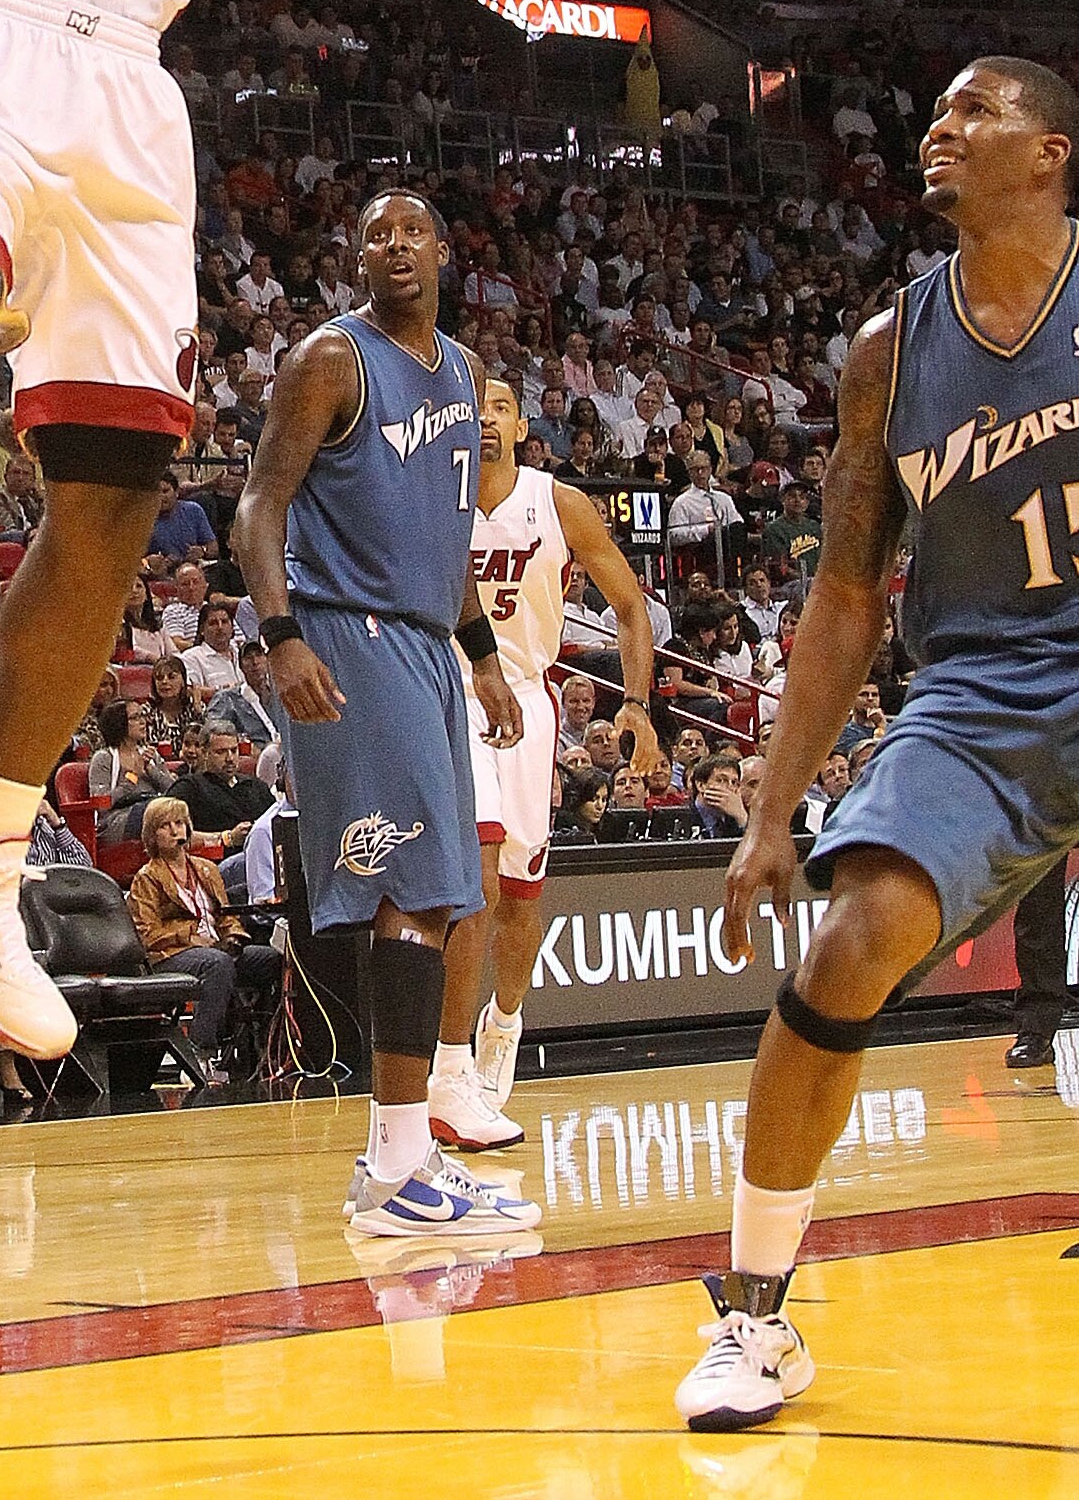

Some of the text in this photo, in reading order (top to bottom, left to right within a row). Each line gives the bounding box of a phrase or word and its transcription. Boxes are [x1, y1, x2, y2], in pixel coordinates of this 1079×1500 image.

[380, 401, 474, 466] WIZARDS
[896, 398, 1079, 514] WIZAR
[451, 447, 472, 512] 7
[471, 536, 542, 582] EAT
[631, 531, 661, 545] WIZARDS
[490, 588, 520, 621] 5
